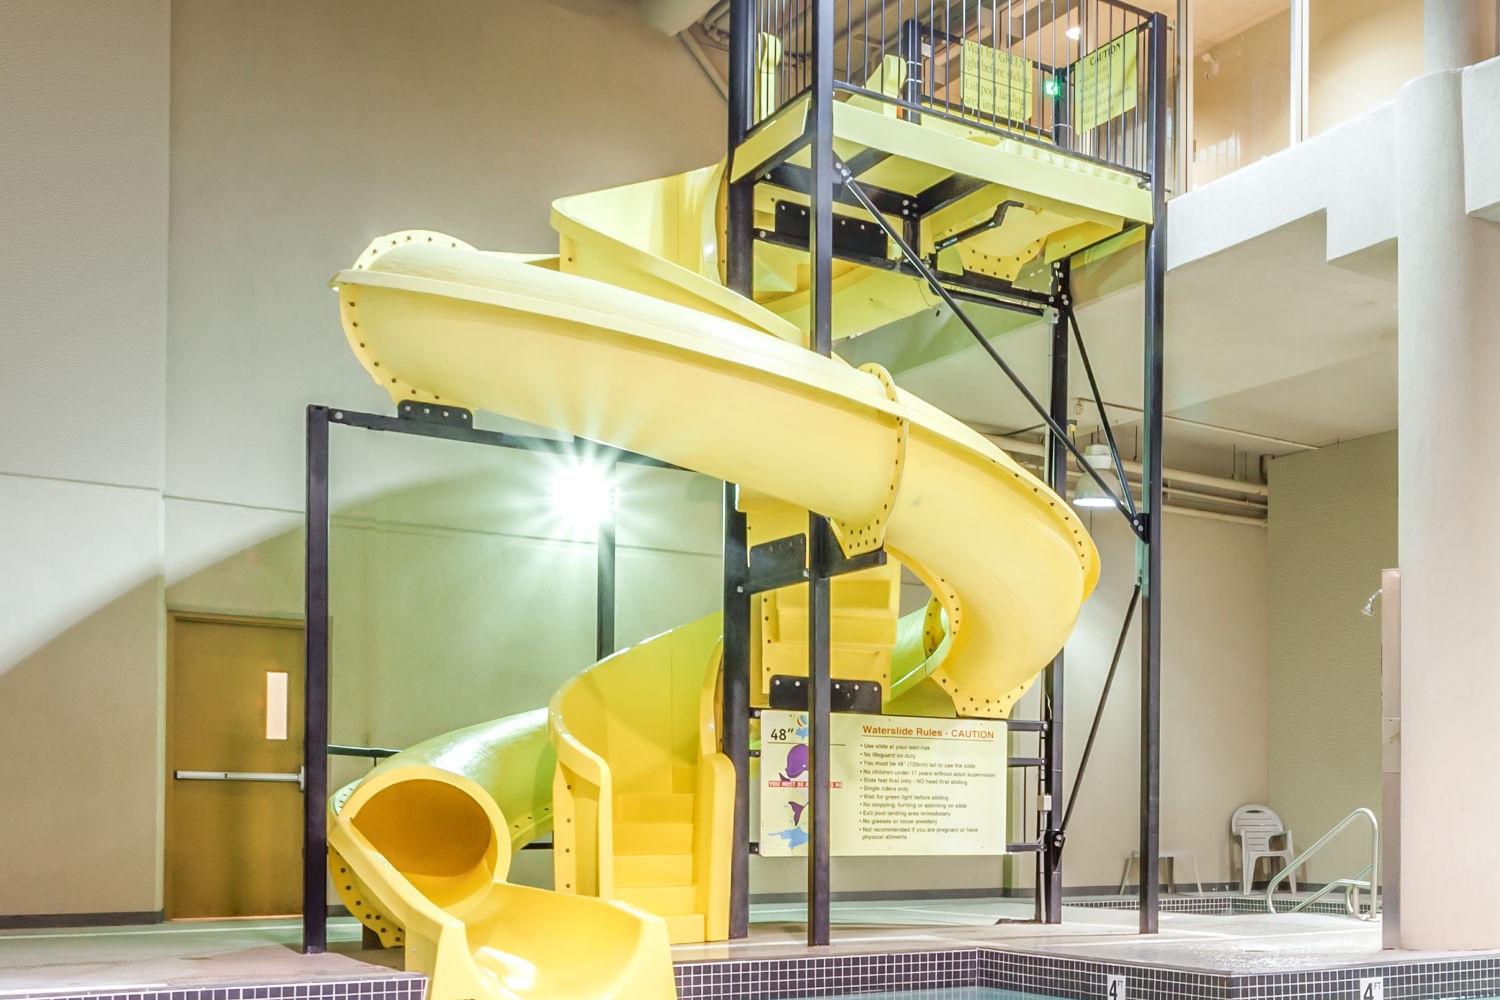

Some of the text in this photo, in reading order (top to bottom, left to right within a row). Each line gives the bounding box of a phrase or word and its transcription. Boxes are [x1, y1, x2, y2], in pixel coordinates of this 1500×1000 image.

[967, 42, 984, 56] Wat
[771, 728, 794, 741] 48"
[863, 725, 913, 735] Waterslide
[917, 728, 942, 736] Rules
[951, 730, 994, 738] CAUTION
[1374, 981, 1381, 990] FT
